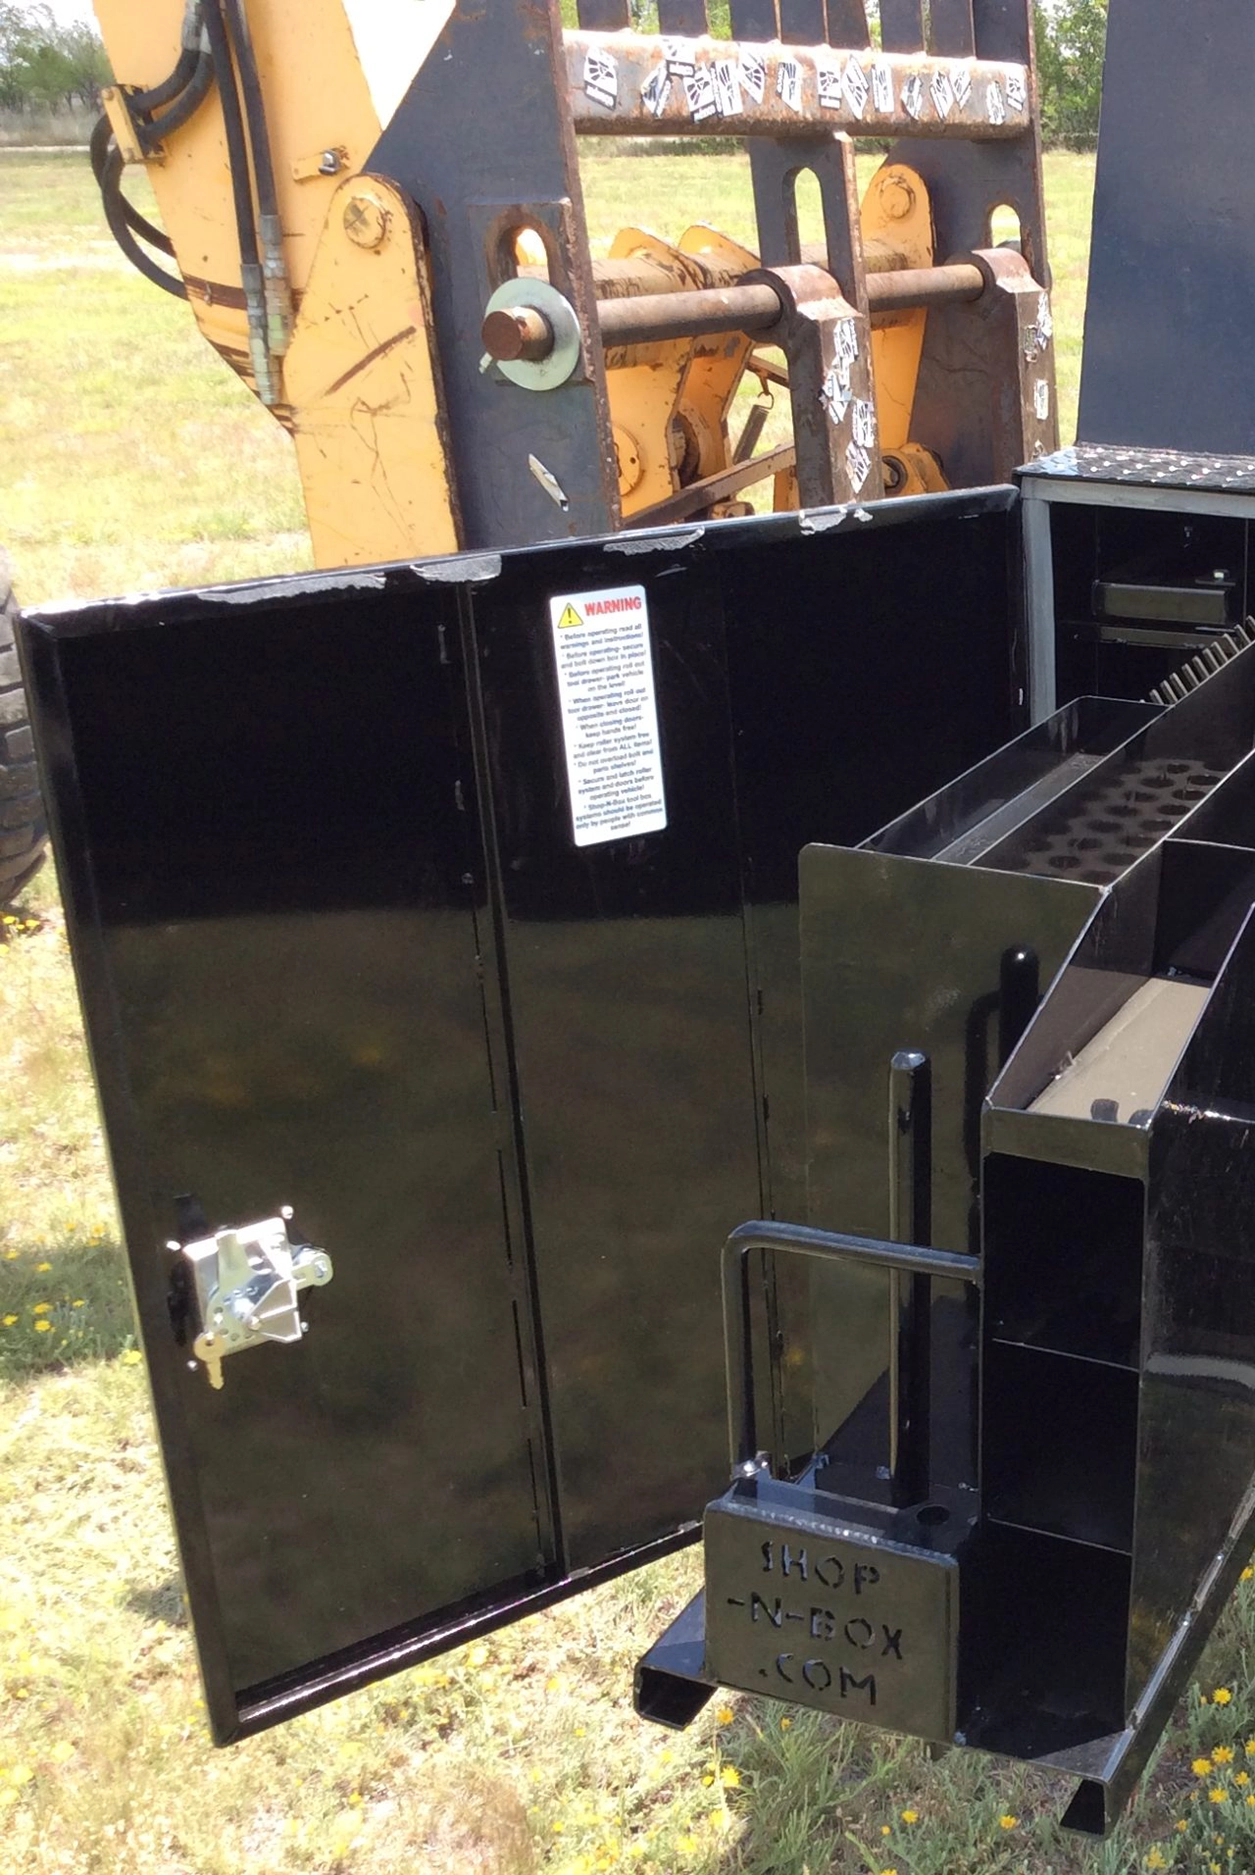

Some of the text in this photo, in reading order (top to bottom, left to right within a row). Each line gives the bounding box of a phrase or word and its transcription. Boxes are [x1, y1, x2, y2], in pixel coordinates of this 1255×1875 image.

[584, 596, 641, 616] WARNING
[587, 628, 618, 637] operating
[591, 665, 621, 674] operating
[606, 673, 620, 681] park
[622, 669, 644, 678] vehicle
[592, 692, 622, 701] operating
[599, 718, 622, 727] closing
[613, 734, 636, 743] system
[582, 776, 604, 785] Secure
[619, 770, 634, 778] latch
[634, 775, 654, 783] before
[589, 790, 619, 800] operating
[761, 1540, 880, 1594] SHOP
[727, 1591, 903, 1660] -N-BOX
[759, 1653, 876, 1705] .COM
